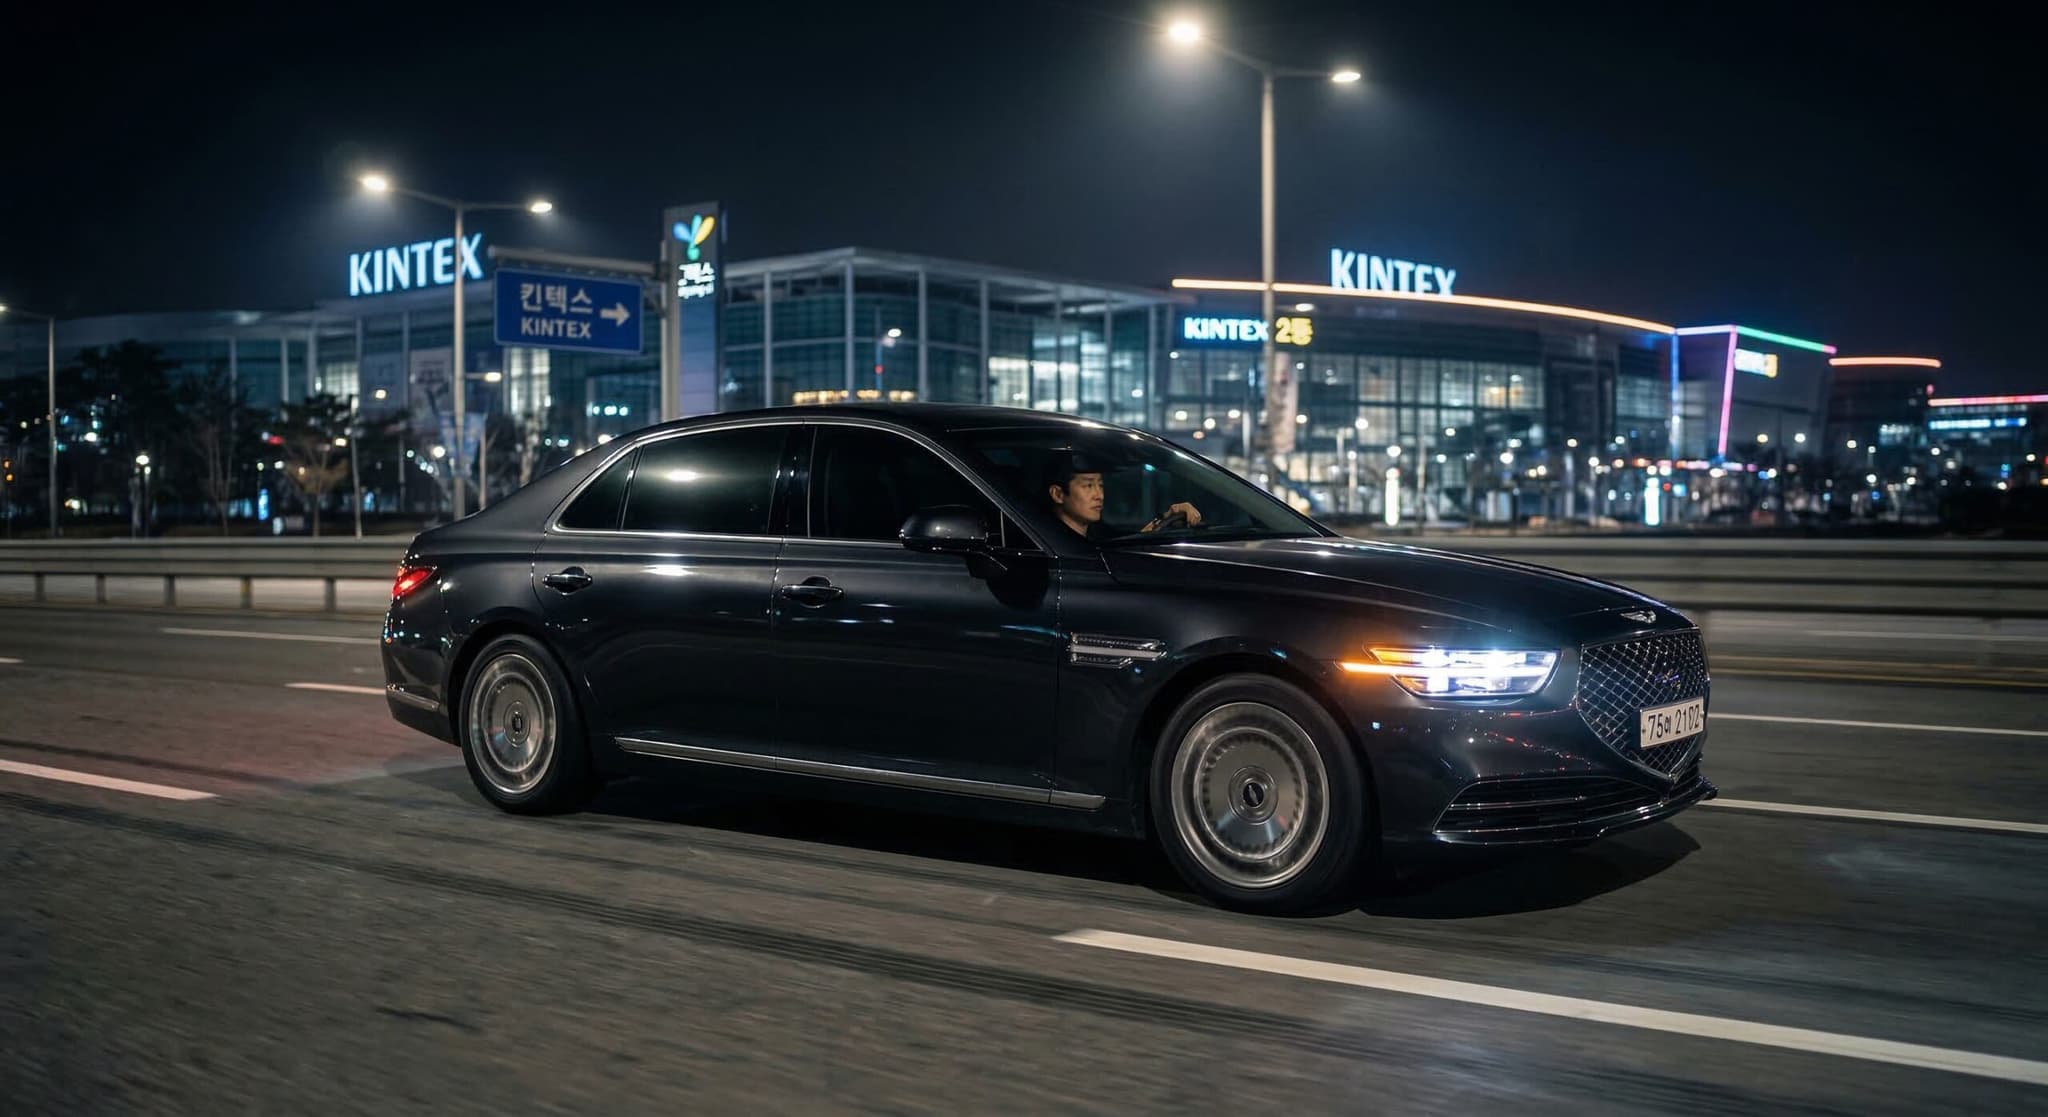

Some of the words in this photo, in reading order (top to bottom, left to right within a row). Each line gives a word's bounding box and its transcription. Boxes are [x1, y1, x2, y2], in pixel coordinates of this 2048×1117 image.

[349, 232, 484, 297] KINTEX
[1331, 248, 1457, 298] KINTEX
[520, 283, 593, 314] 킨텍스
[521, 317, 592, 339] KINTEX
[1184, 317, 1270, 342] KINTEX
